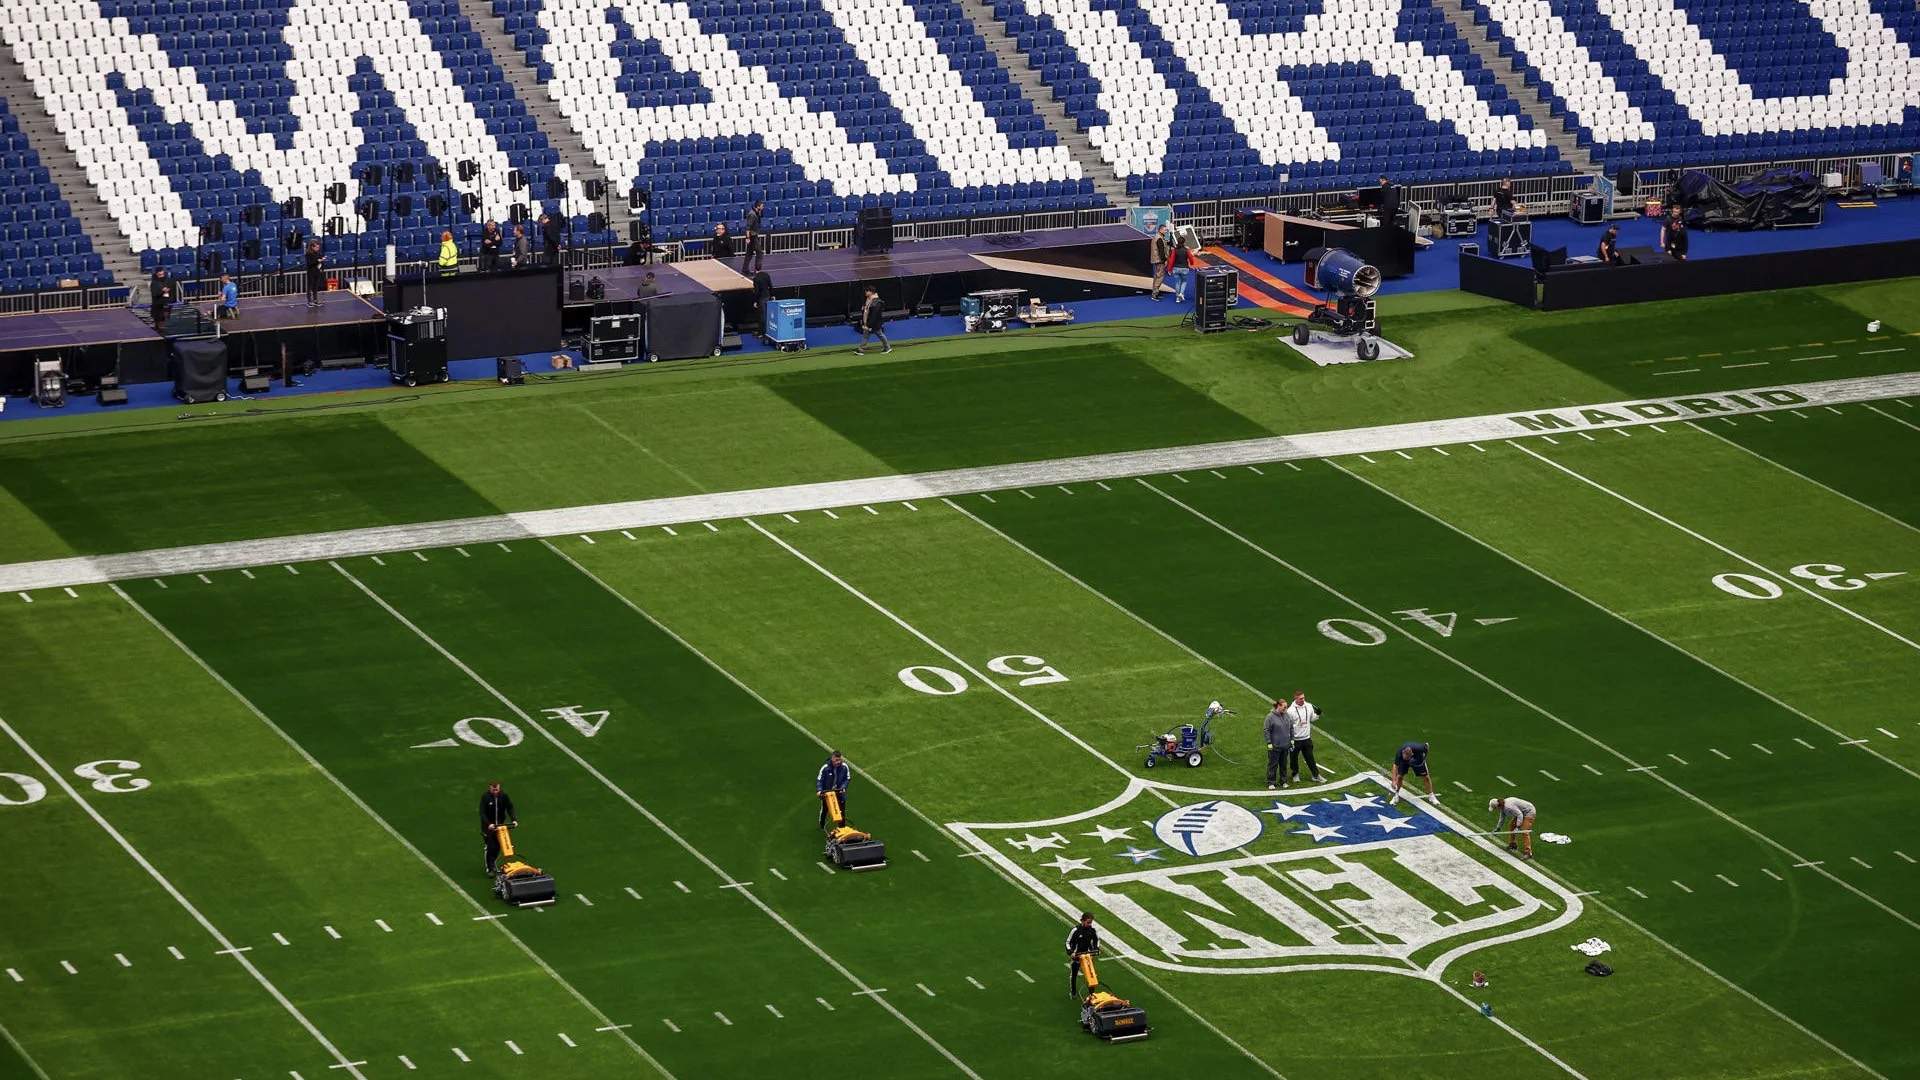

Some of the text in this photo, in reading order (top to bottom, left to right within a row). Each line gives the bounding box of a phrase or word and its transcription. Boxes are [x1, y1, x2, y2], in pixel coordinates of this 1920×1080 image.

[1507, 388, 1809, 432] MADRID
[1712, 563, 1867, 601] 30
[1316, 607, 1458, 647] 40
[898, 654, 1070, 696] 50
[451, 704, 611, 749] 40
[1096, 846, 1531, 950] NFL
